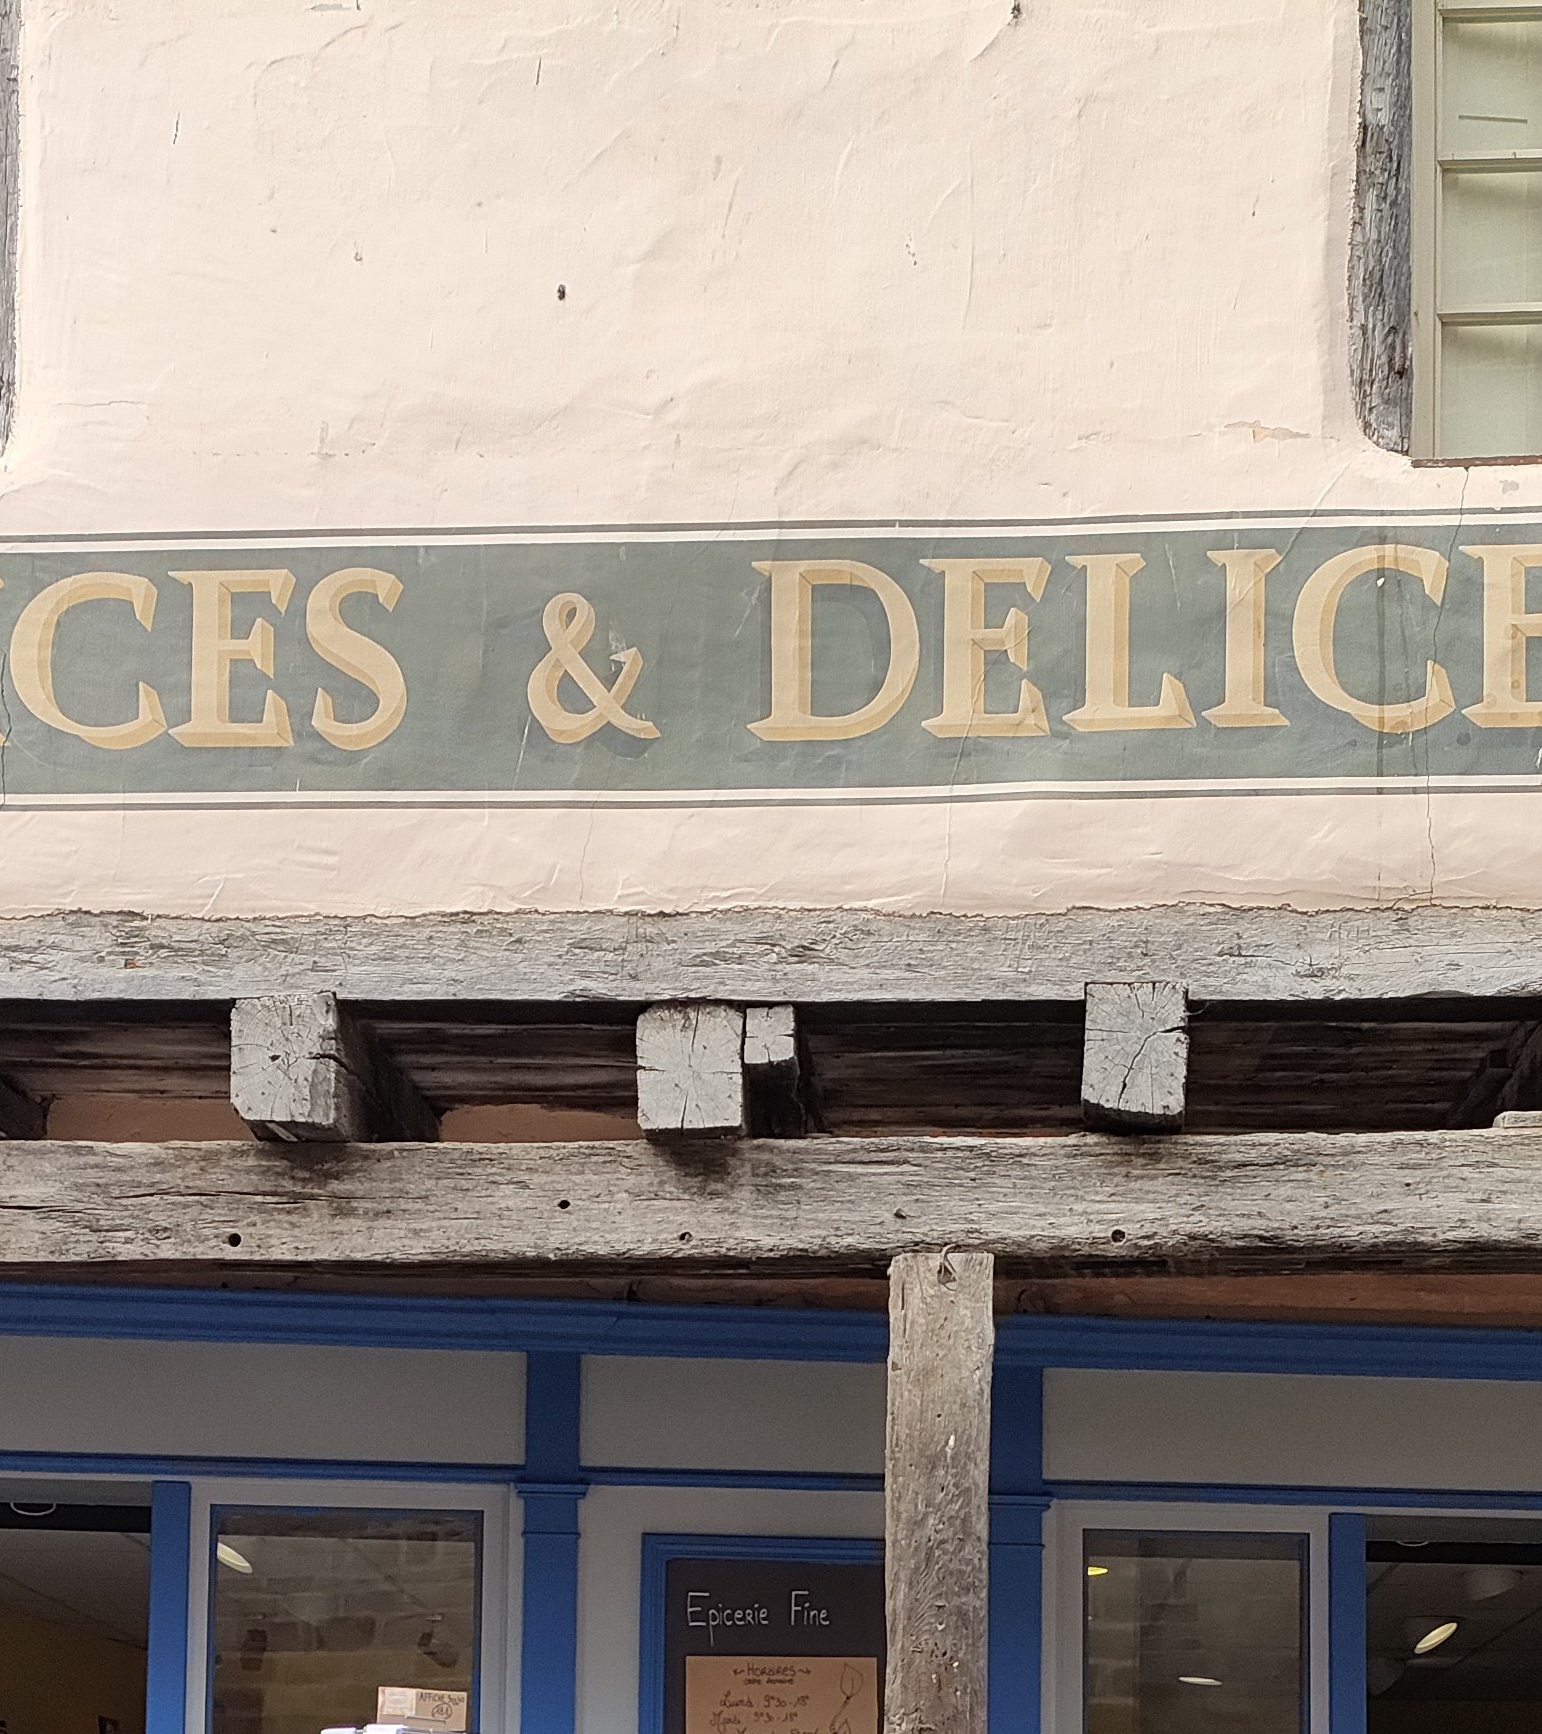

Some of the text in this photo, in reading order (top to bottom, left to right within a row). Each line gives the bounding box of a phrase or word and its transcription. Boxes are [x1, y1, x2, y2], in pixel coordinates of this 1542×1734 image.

[525, 592, 660, 744] &
[687, 1590, 830, 1648] Epicerie Fine
